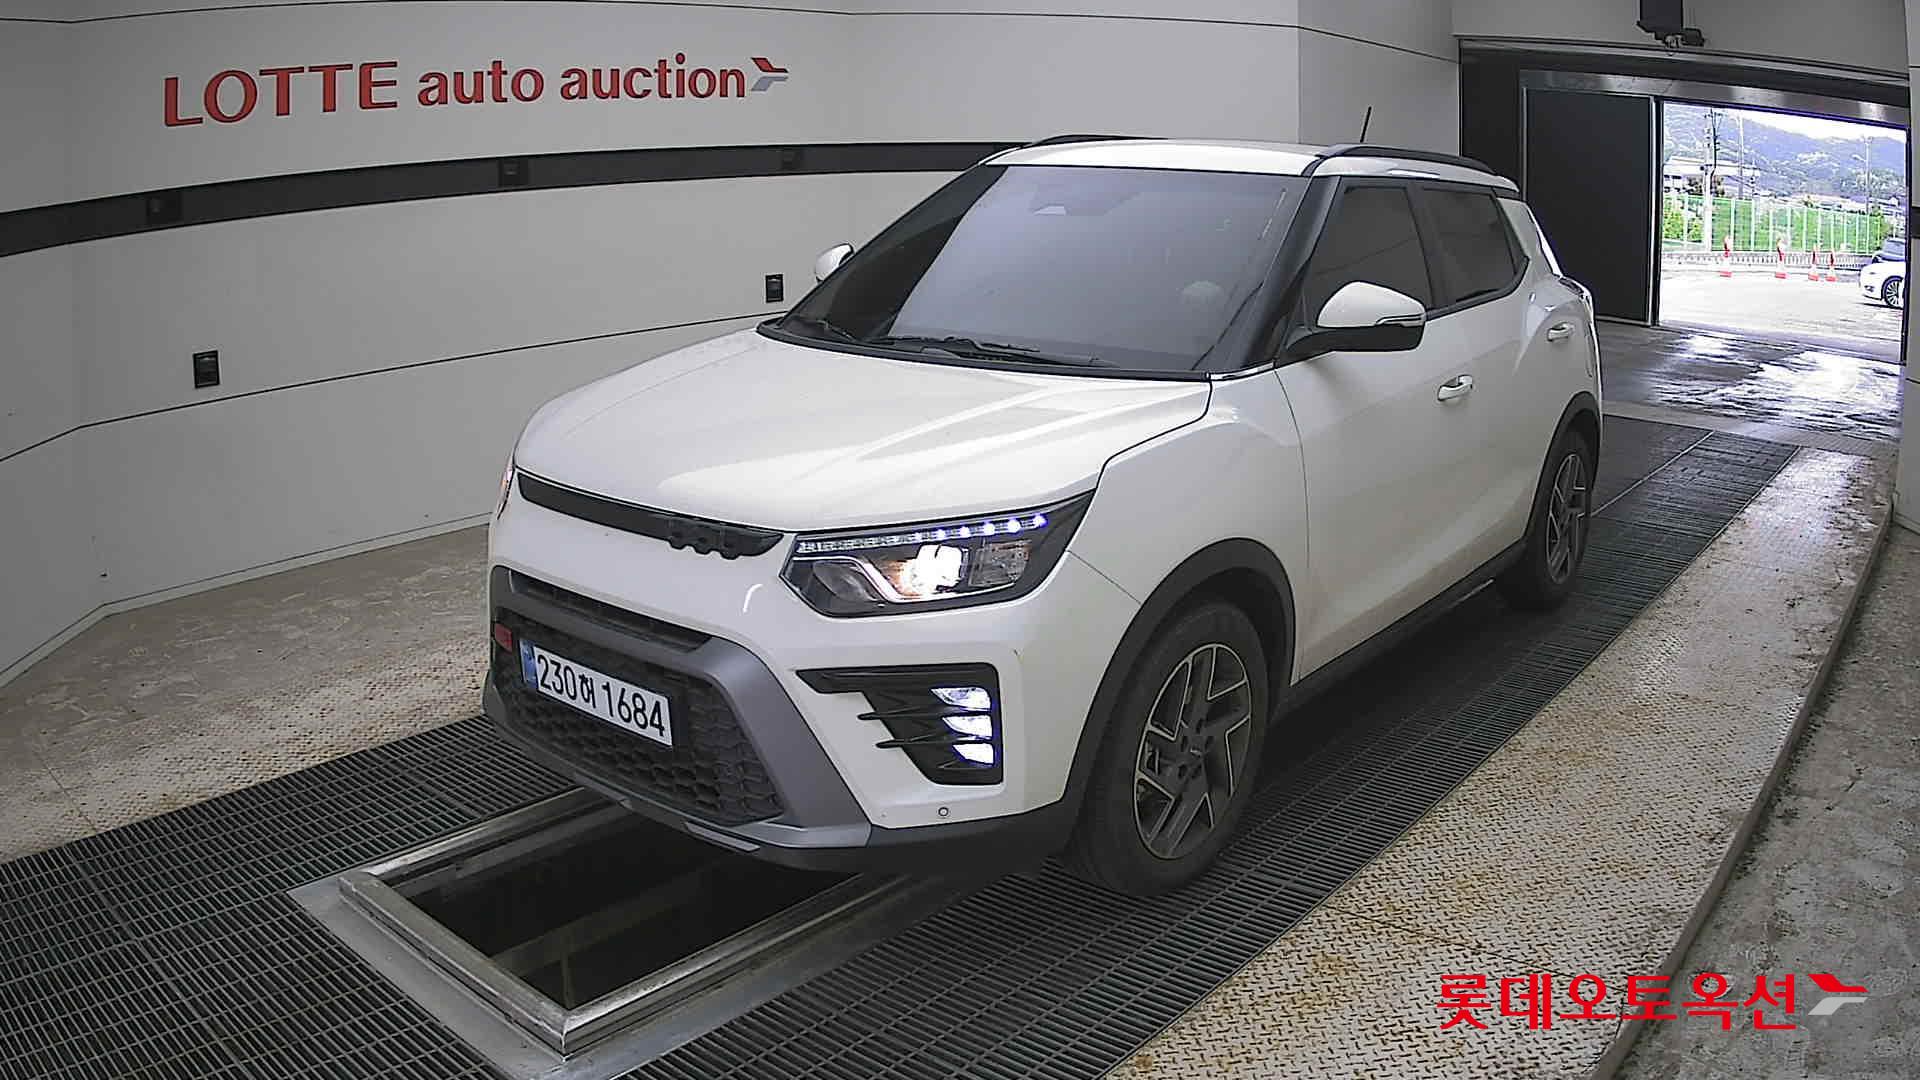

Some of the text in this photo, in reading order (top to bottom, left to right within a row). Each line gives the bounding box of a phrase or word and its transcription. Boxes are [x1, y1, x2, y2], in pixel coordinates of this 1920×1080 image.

[164, 54, 745, 127] LOTTE auto auction
[537, 654, 665, 736] 230허 1684
